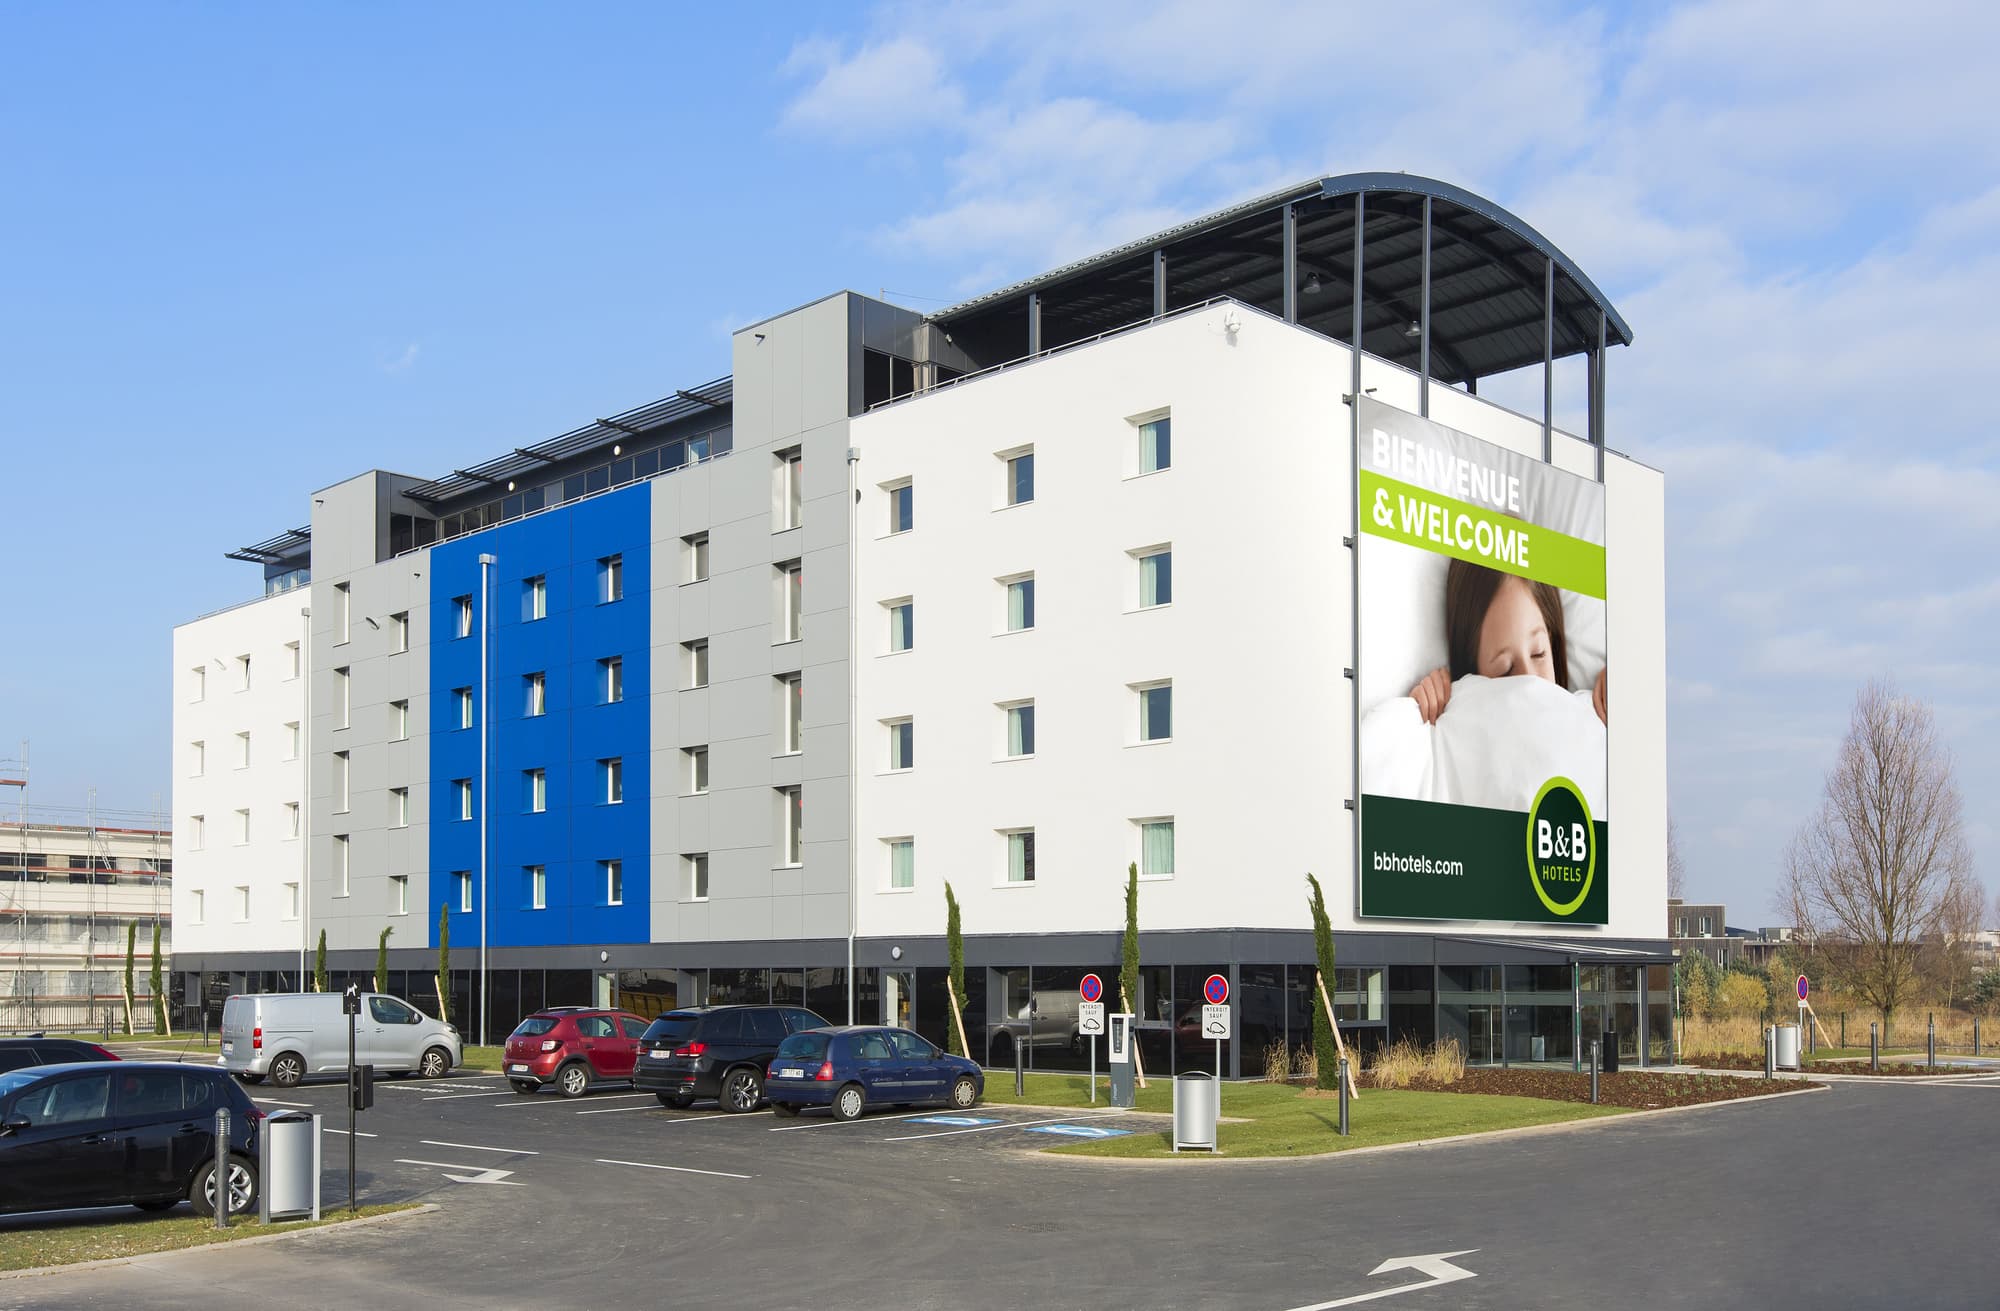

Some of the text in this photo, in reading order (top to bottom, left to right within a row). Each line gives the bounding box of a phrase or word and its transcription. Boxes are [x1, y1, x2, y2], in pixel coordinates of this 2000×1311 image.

[1372, 428, 1520, 513] BIENVENUE
[1372, 487, 1529, 568] & WELCOME
[1537, 819, 1587, 862] B&B
[1374, 852, 1463, 876] bbhotels.com
[1542, 865, 1581, 882] HOTELS
